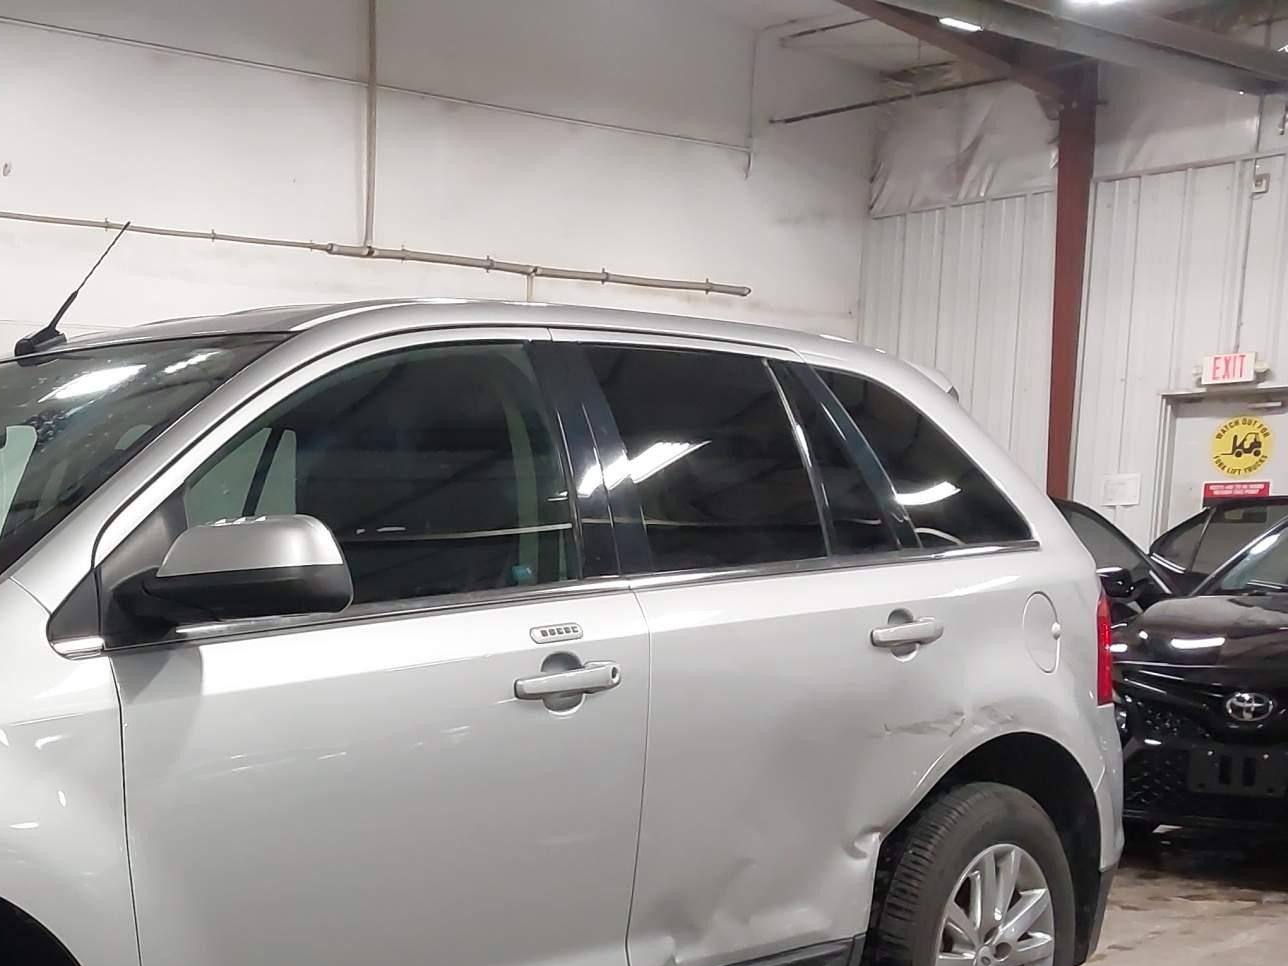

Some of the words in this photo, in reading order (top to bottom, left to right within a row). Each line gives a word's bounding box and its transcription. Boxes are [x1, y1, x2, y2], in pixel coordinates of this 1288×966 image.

[1212, 354, 1247, 381] EXIT
[1215, 419, 1240, 440] WATCH
[1241, 417, 1258, 426] OUT
[1257, 423, 1271, 438] FOR
[1213, 455, 1227, 471] FORK
[1227, 467, 1242, 475] LIFT
[1243, 455, 1268, 473] TRUCKS
